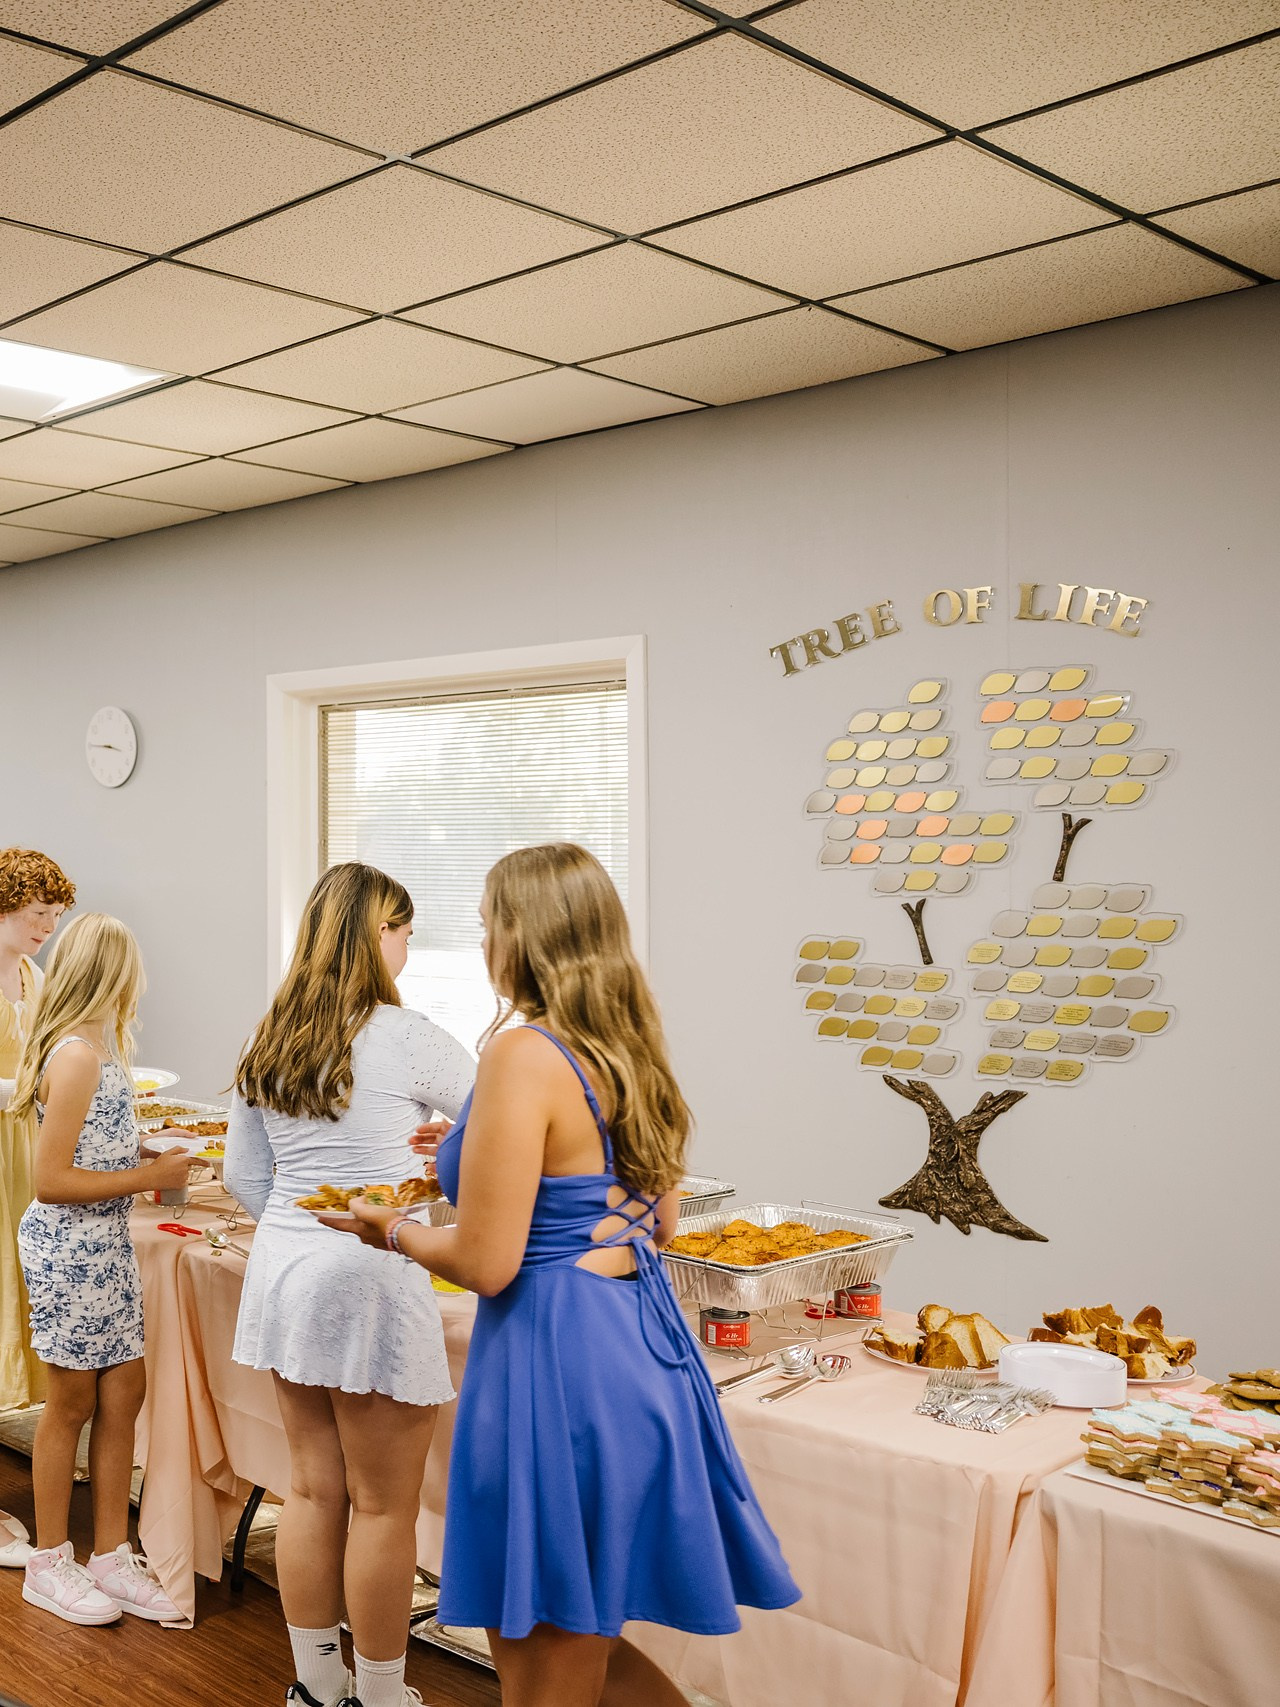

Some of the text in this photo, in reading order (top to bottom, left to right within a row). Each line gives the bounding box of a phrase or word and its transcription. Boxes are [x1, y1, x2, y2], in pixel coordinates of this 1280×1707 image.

[769, 582, 1149, 678] TREE OF LIFE
